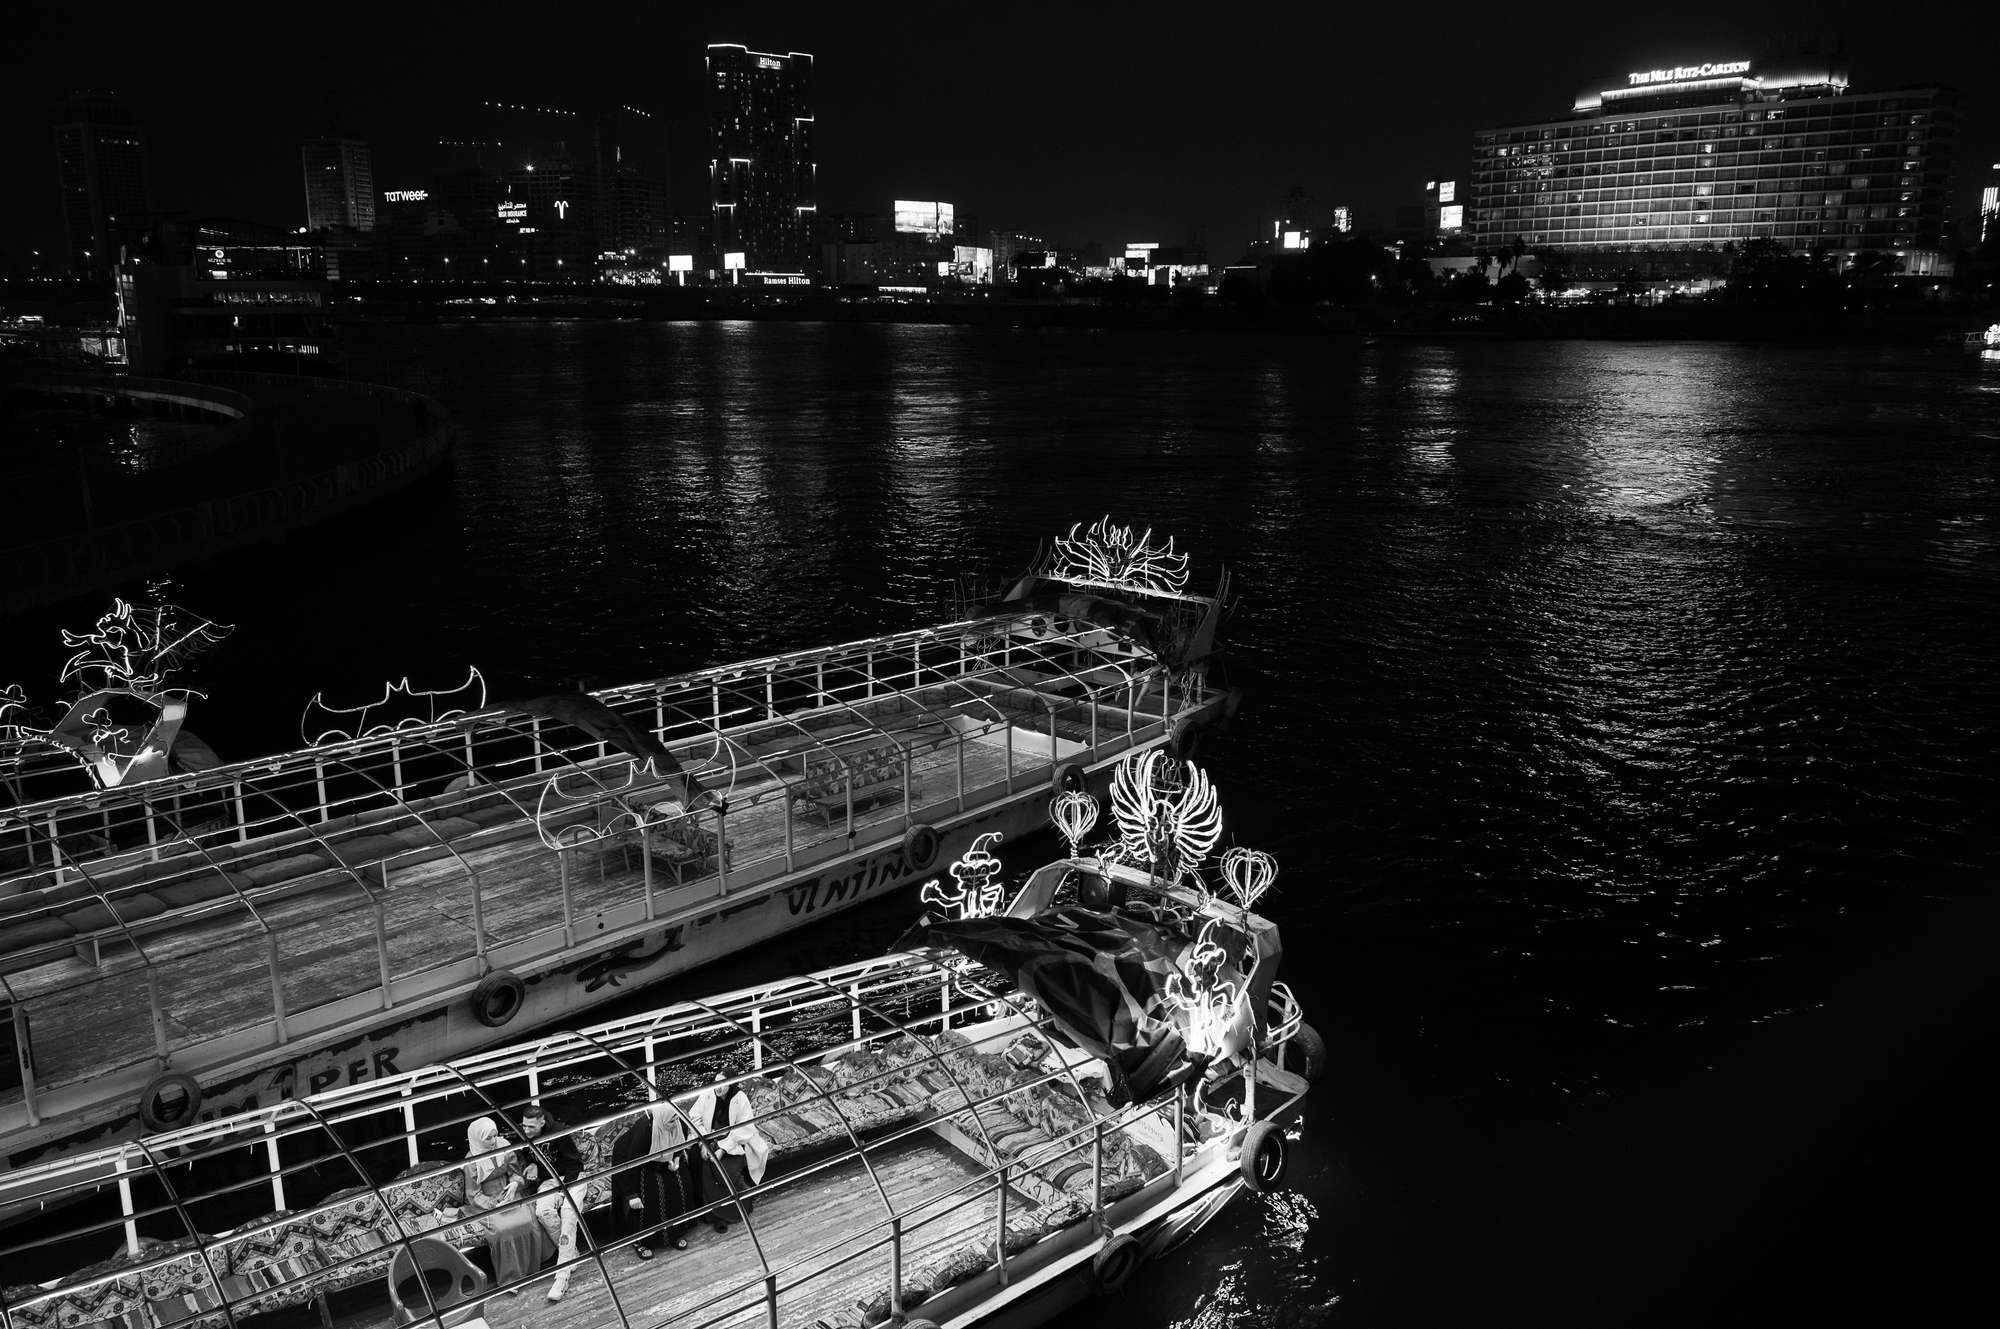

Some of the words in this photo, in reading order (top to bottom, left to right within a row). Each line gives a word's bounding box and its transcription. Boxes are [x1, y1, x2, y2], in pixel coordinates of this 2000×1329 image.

[760, 57, 781, 67] Hilton
[1629, 72, 1650, 84] THE
[1650, 70, 1673, 82] NILE
[1674, 61, 1751, 80] RITZ-CARLTON
[763, 276, 787, 285] Ramses
[788, 276, 811, 285] Hilton
